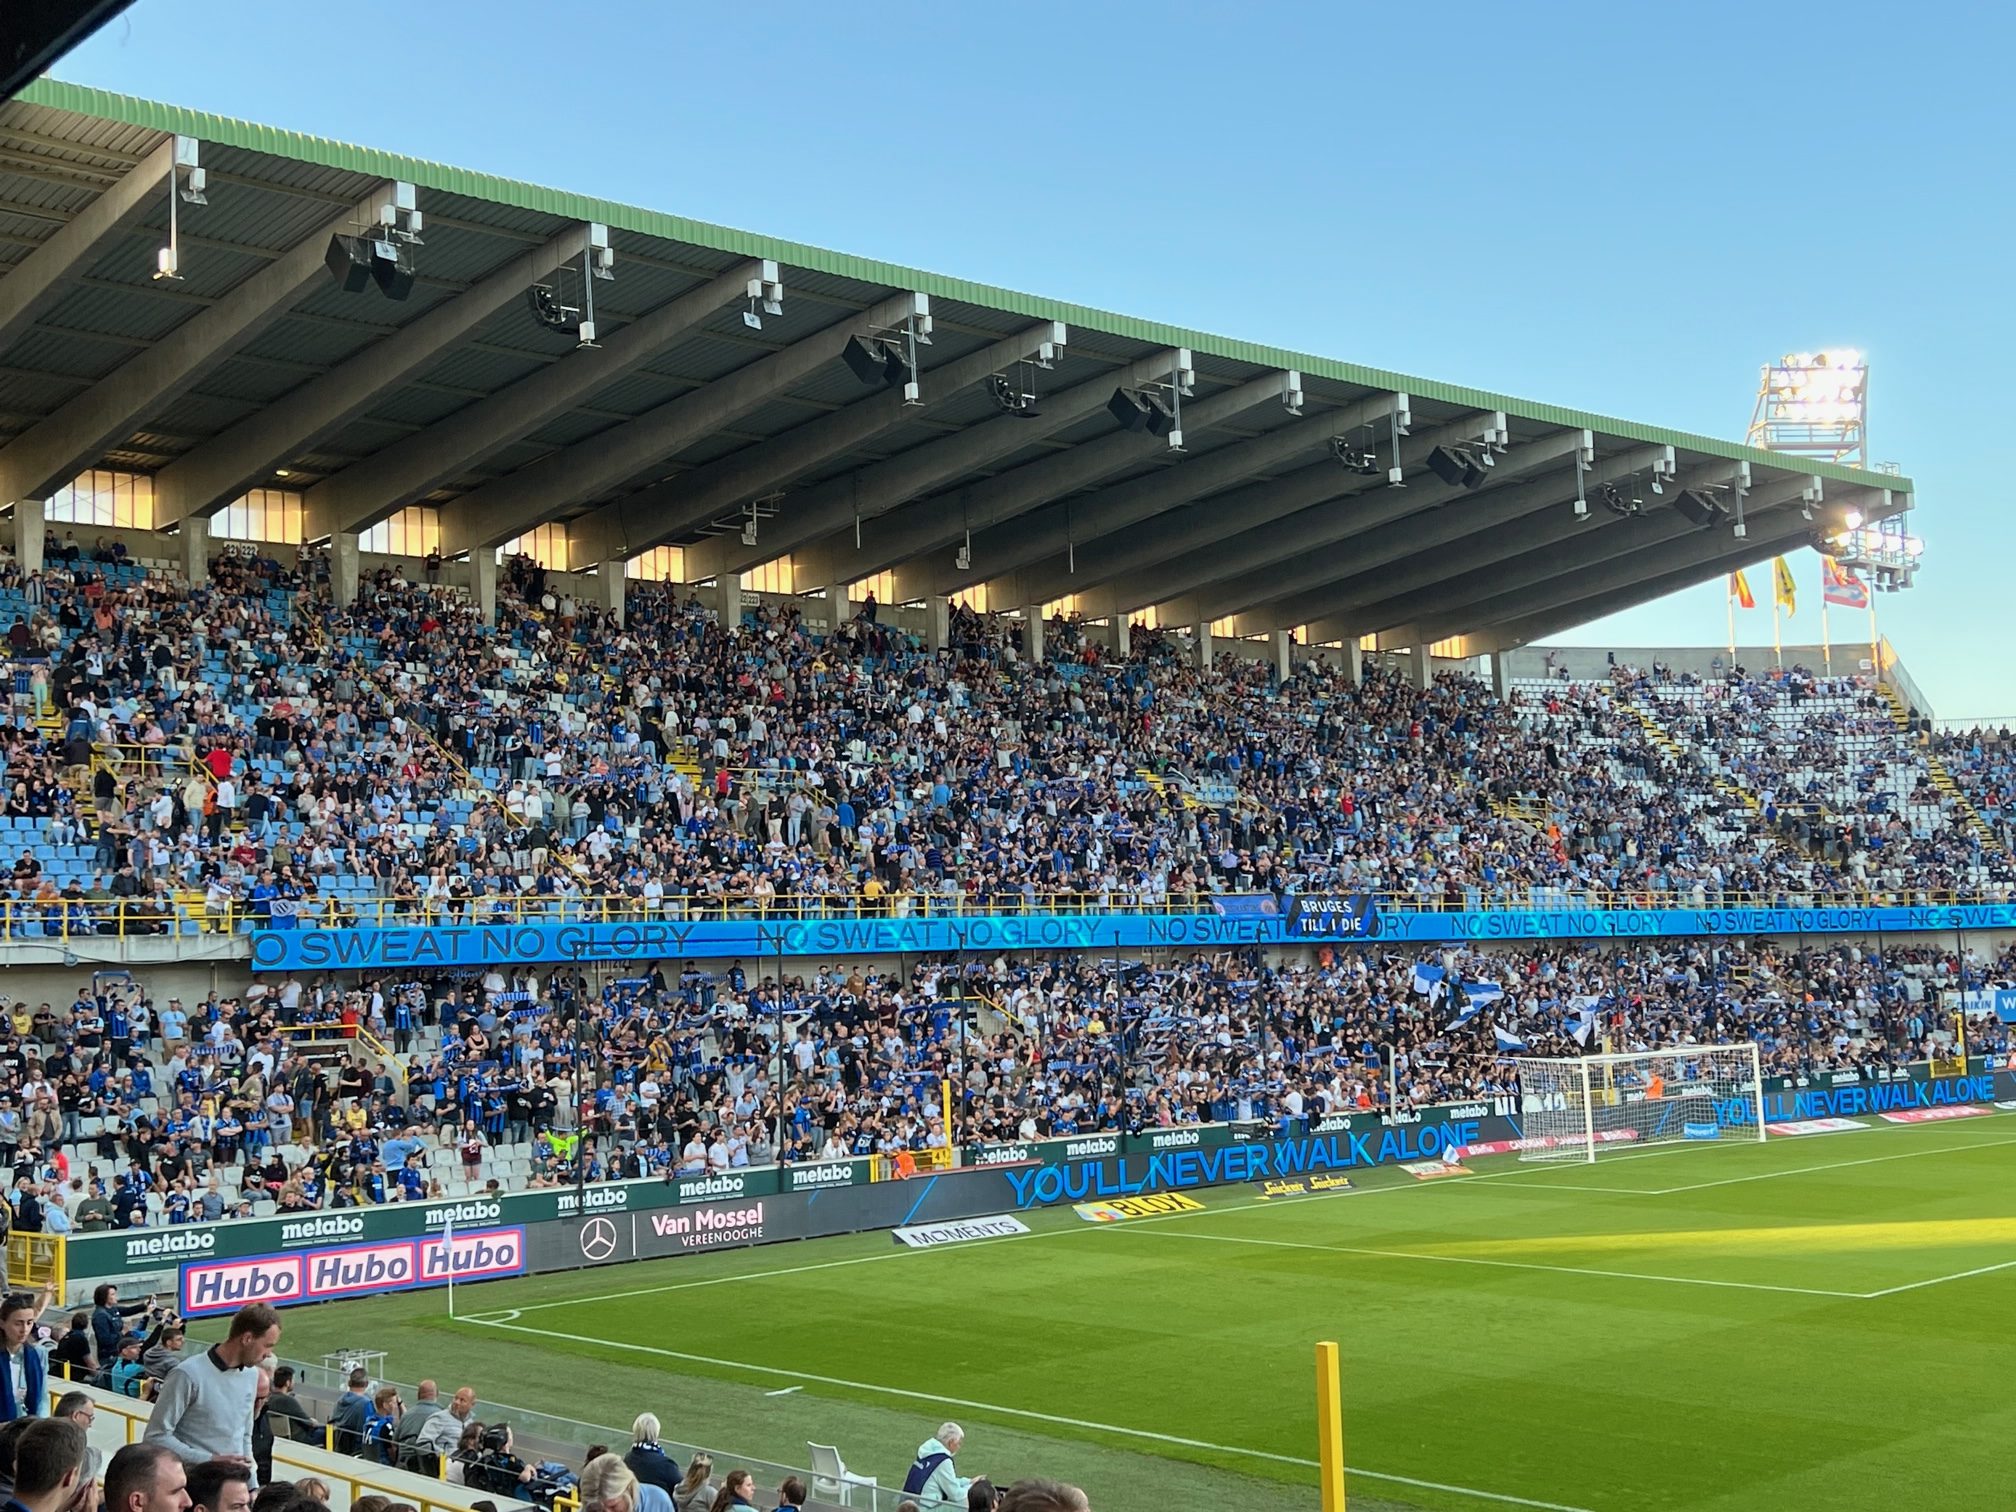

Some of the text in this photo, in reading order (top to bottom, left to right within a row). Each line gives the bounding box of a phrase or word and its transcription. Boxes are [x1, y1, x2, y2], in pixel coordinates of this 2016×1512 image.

[1300, 900, 1353, 914] BRUGES
[1907, 909, 1941, 927] NO
[1147, 917, 1285, 942] NO SWEAT
[1300, 917, 1326, 933] TILL
[1331, 918, 1337, 931] I
[1341, 917, 1362, 931] DIE
[1451, 912, 1665, 937] NO SWEAT NO GLORY
[1695, 910, 1875, 933] NO SWEAT NO GLORY
[300, 929, 471, 965] SWEAT
[483, 928, 546, 960] NO
[556, 925, 694, 957] GLORY
[757, 918, 1101, 952] NO SWEAT NO GLORY
[1450, 1105, 1488, 1120] metabo
[1711, 1095, 1792, 1128] YOULL
[1794, 1087, 1868, 1117] NEVER
[1870, 1081, 1930, 1112] WALK
[1932, 1075, 1995, 1104] ALONE
[1310, 1116, 1351, 1132] etabo
[1066, 1138, 1116, 1156] metabo
[1153, 1130, 1200, 1148] metabo
[975, 1146, 1028, 1165] etabo
[793, 1164, 853, 1184] metabo
[1005, 1158, 1143, 1206] YOU'LL
[1150, 1144, 1270, 1190] NEVER
[1274, 1132, 1375, 1174] WALK
[679, 1175, 744, 1197] metabo
[557, 1187, 628, 1210] metabo
[1106, 1194, 1198, 1216] BLOX
[425, 1201, 501, 1225] metabo
[651, 1202, 763, 1237] Van Mossel
[281, 1215, 364, 1240] metabo
[681, 1226, 763, 1247] VEREENOOGHE
[910, 1221, 1018, 1245] MOMENTS
[126, 1230, 216, 1256] metabo
[426, 1240, 516, 1276] Hubo
[314, 1254, 408, 1291] Hubo
[195, 1267, 295, 1305] Hubo
